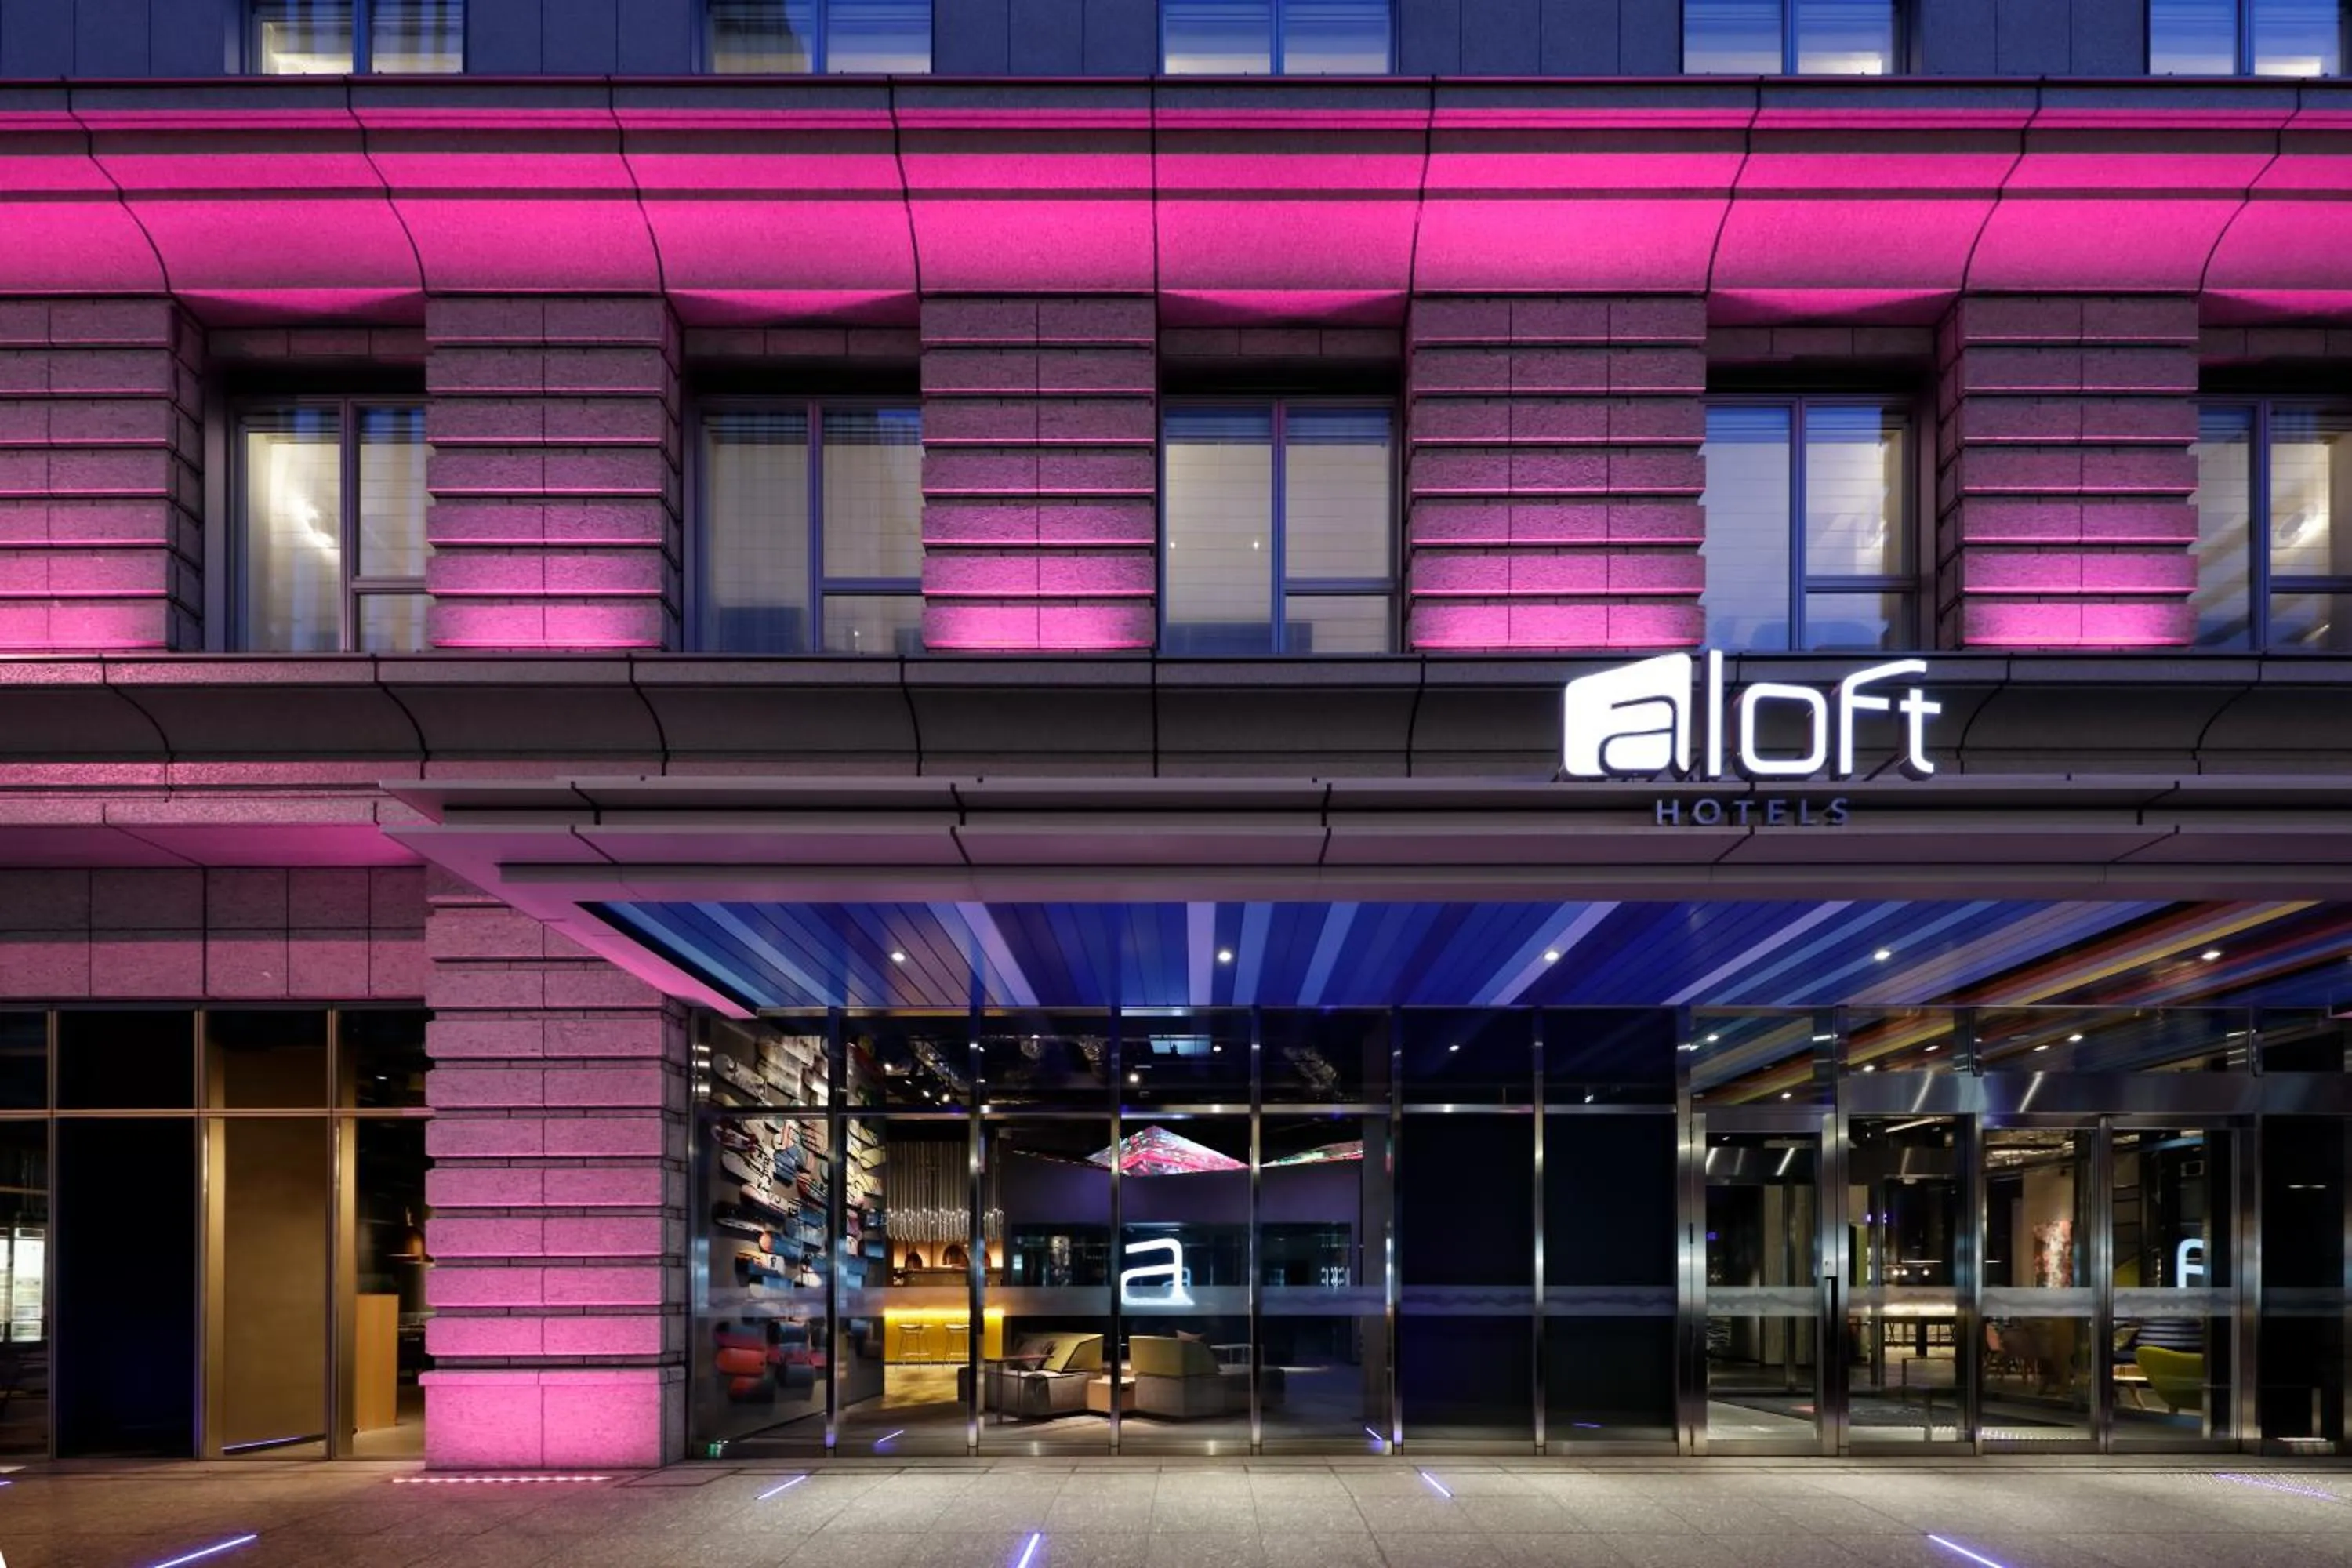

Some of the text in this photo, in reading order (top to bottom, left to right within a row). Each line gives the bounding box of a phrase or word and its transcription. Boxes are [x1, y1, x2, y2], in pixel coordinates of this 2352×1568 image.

[1564, 649, 1941, 778] aloft
[1656, 797, 1851, 826] HOTELS
[1120, 1237, 1195, 1306] a
